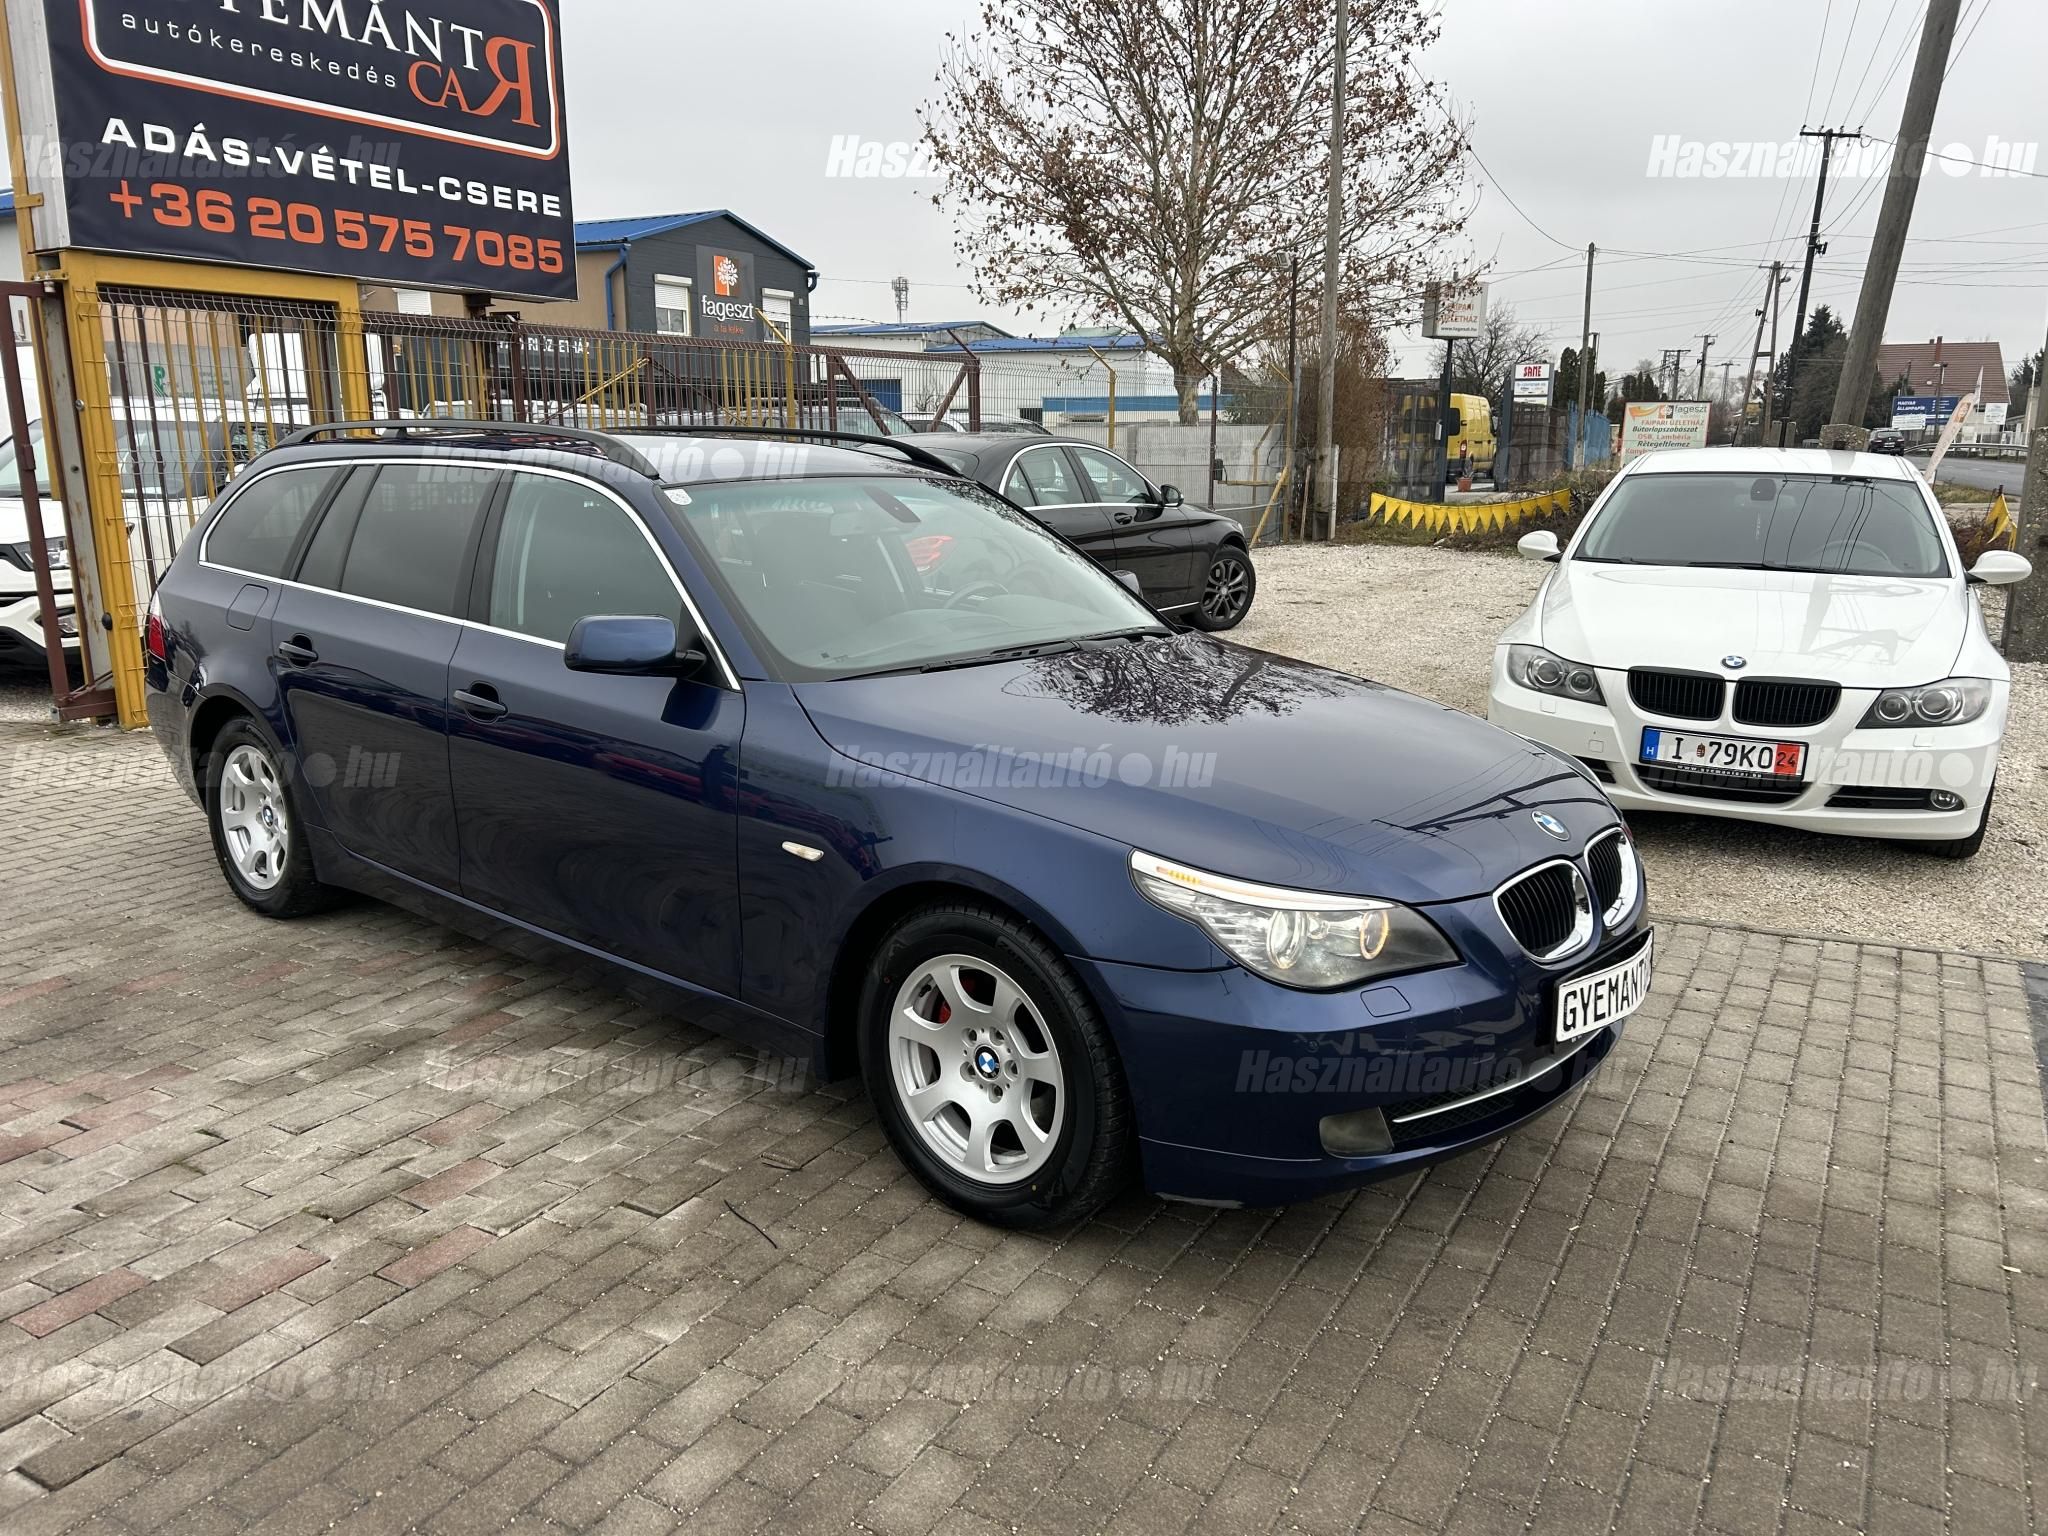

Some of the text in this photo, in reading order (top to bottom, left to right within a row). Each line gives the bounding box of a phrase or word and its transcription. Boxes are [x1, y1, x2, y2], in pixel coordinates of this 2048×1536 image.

[122, 11, 397, 88] autókereskedés
[101, 117, 562, 217] ADÁS-VÉTEL-CSERE
[109, 179, 564, 274] +36 20 575 7085
[701, 294, 755, 322] fageszt
[1675, 405, 1707, 414] fageszt
[1645, 747, 1654, 756] H
[1776, 752, 1796, 768] 24
[1563, 955, 1649, 1032] GYEMANT
